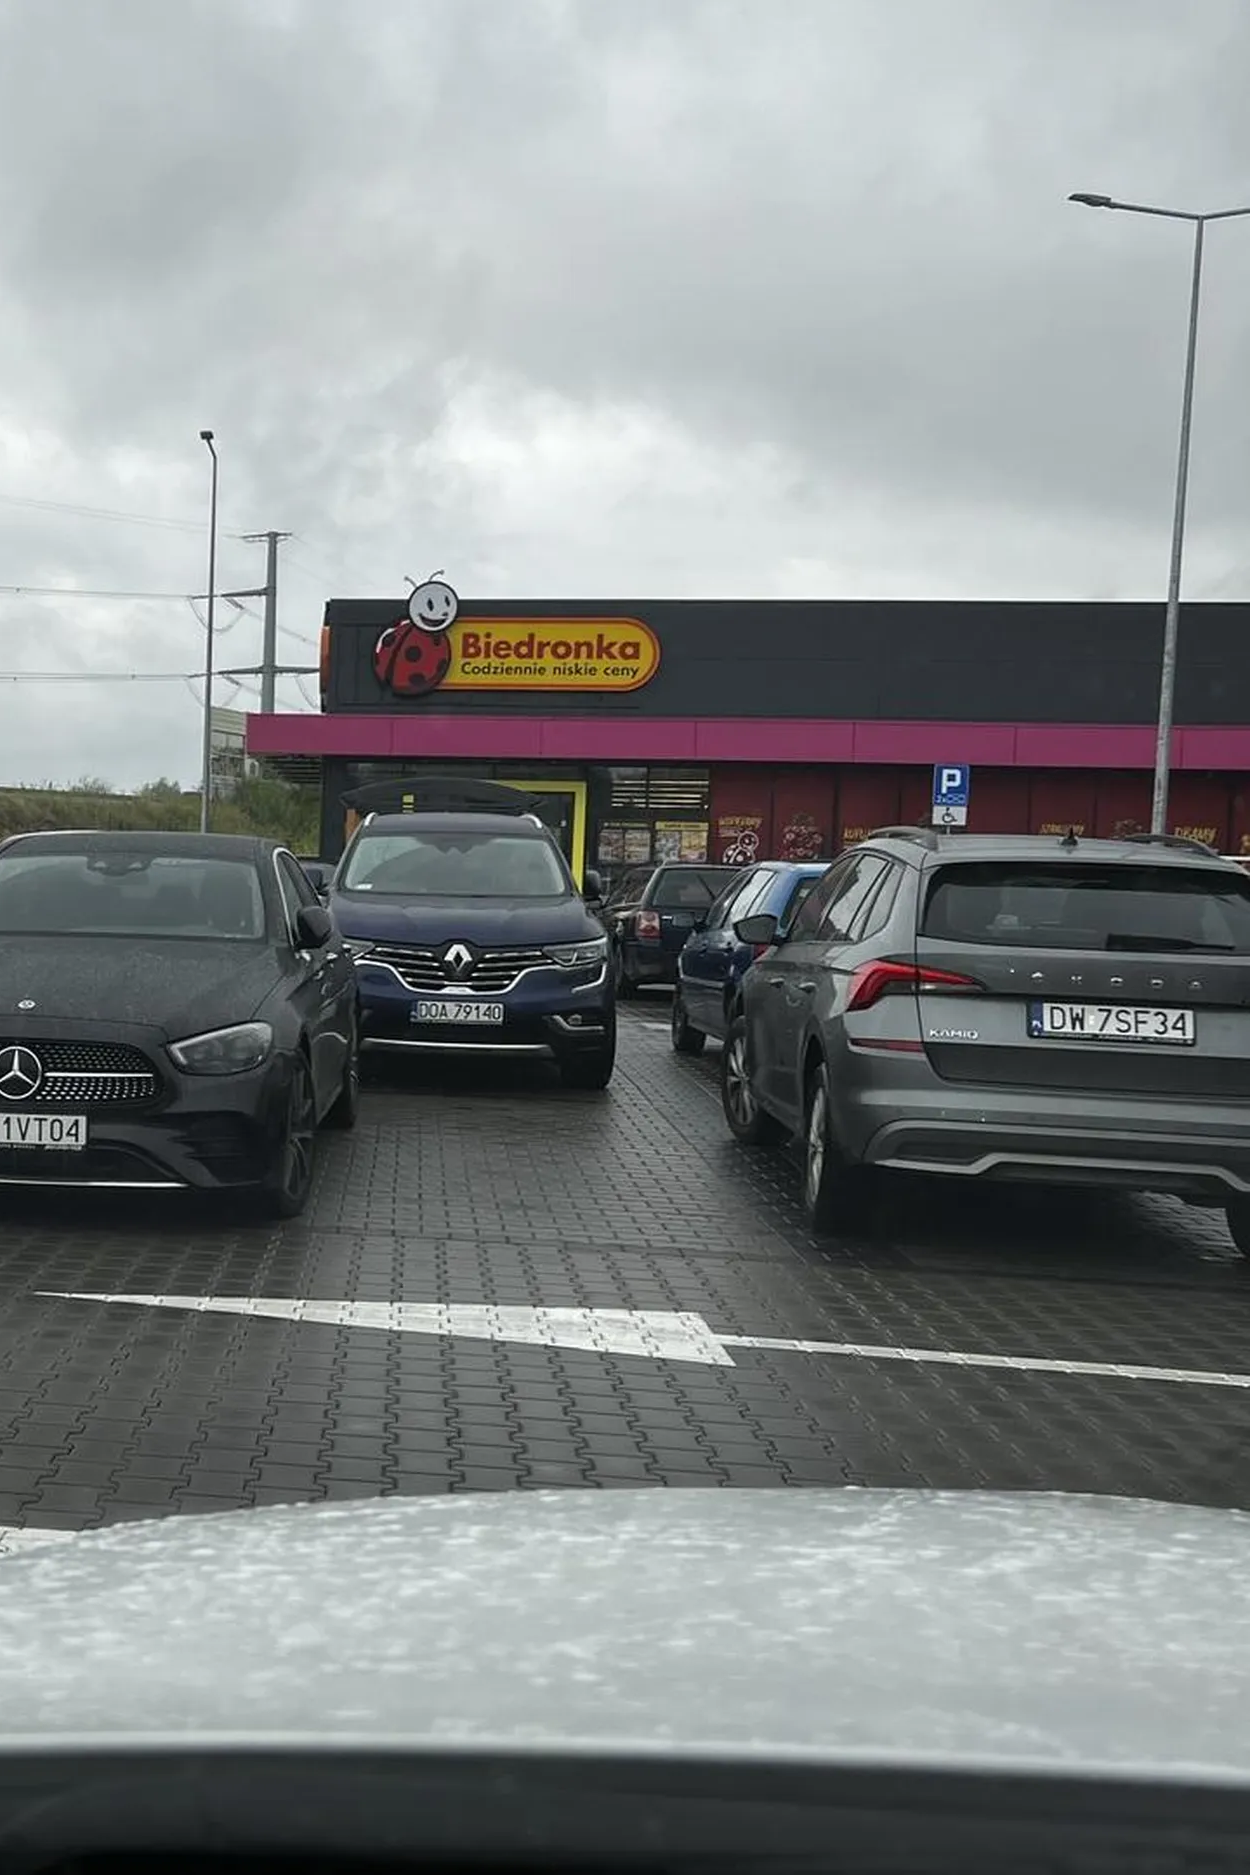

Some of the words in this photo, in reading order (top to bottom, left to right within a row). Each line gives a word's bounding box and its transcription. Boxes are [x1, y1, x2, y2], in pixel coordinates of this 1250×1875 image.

[461, 632, 641, 660] Biedronka
[461, 661, 547, 676] Codziennie
[552, 662, 598, 676] niskie
[603, 667, 640, 679] ceny
[941, 768, 962, 794] P
[419, 1002, 449, 1019] DOA
[454, 1003, 502, 1020] 79140
[1050, 1005, 1086, 1032] DW
[1097, 1007, 1187, 1038] 7SF34
[2, 1115, 80, 1143] 1VT04
